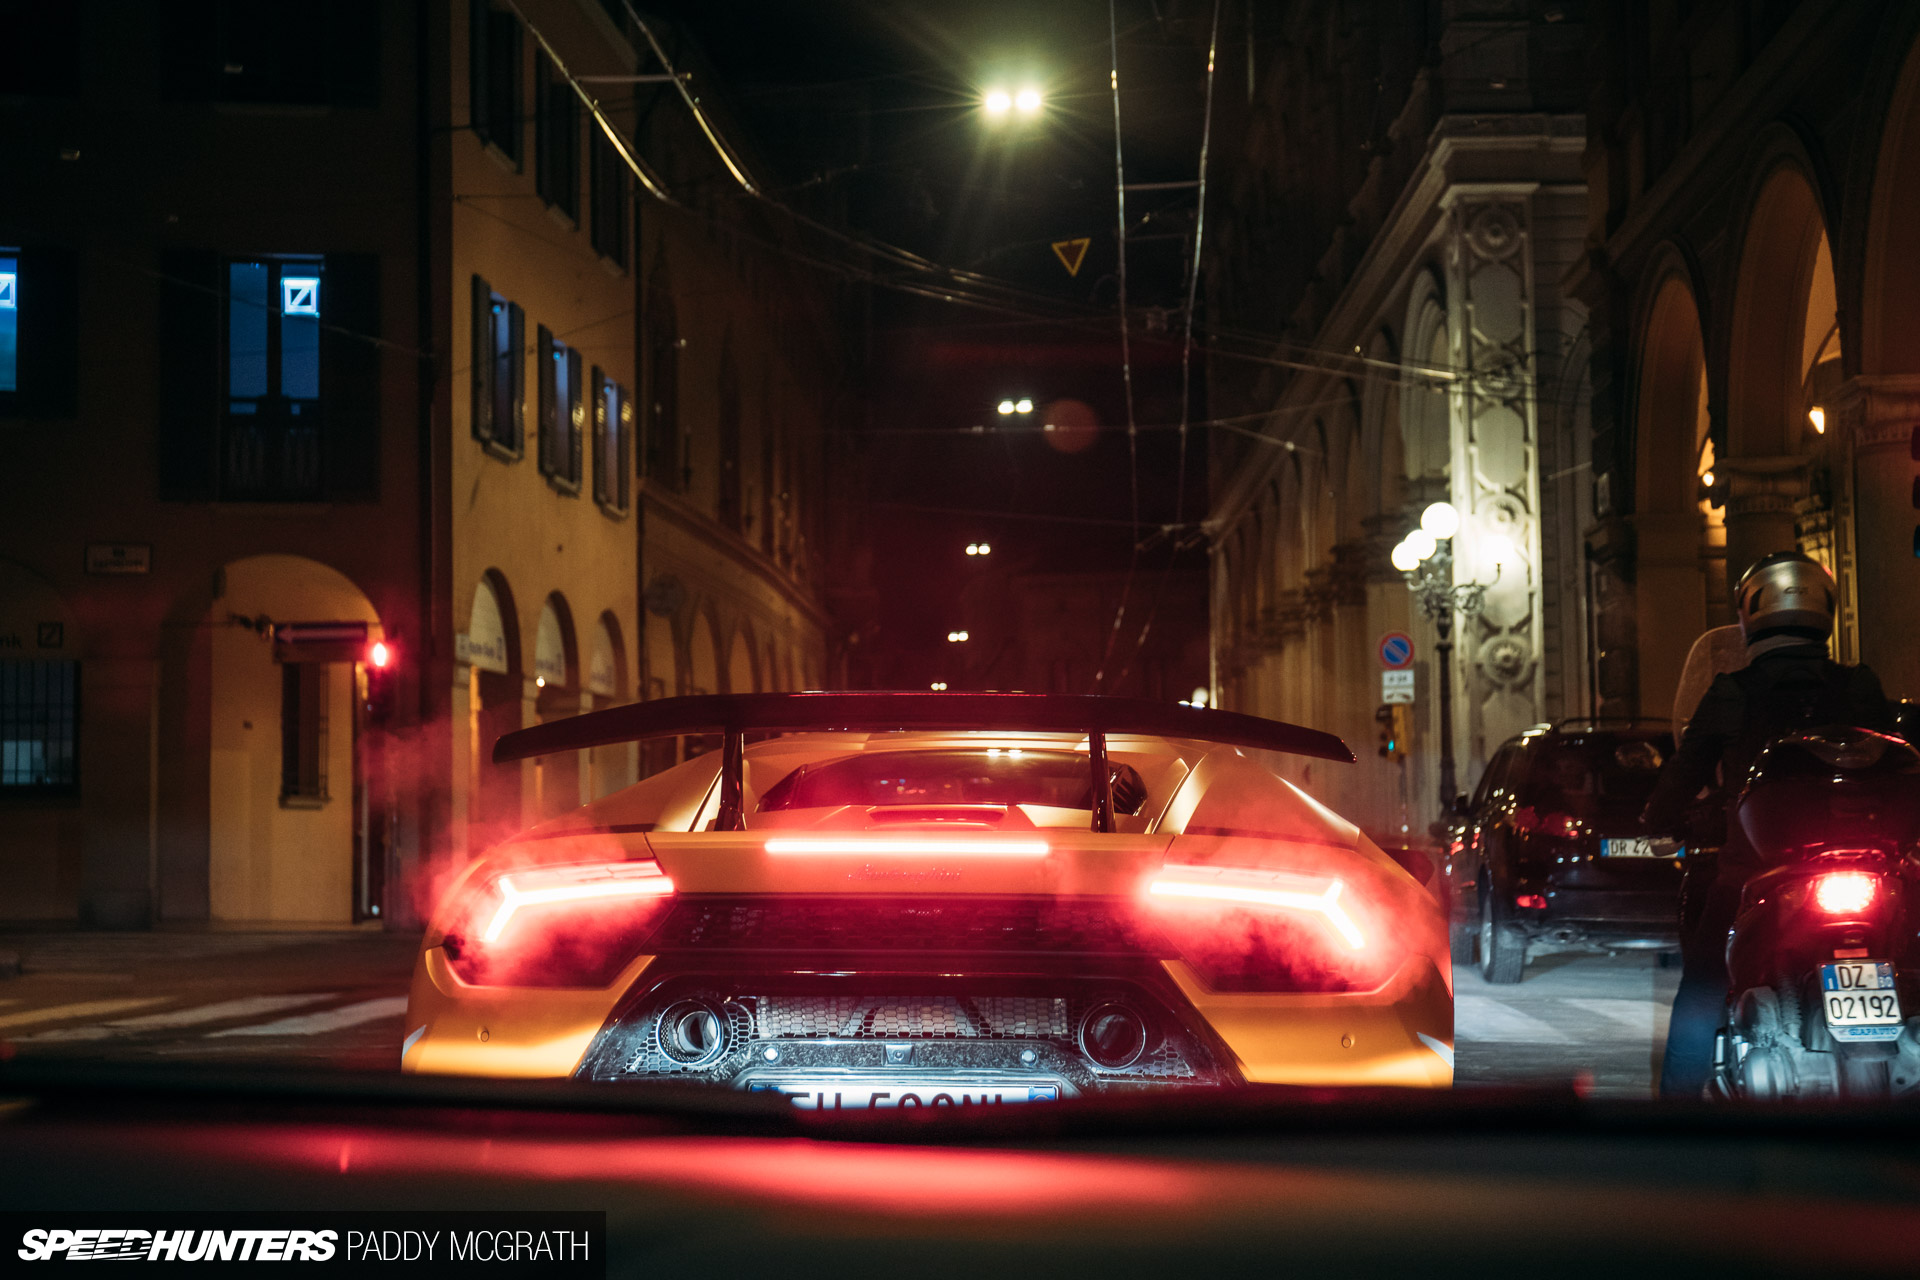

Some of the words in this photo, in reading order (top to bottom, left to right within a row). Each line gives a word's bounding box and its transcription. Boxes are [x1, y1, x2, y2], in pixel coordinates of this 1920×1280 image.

[1610, 841, 1627, 854] DR
[1838, 966, 1867, 988] DZ
[1830, 996, 1896, 1019] 02192
